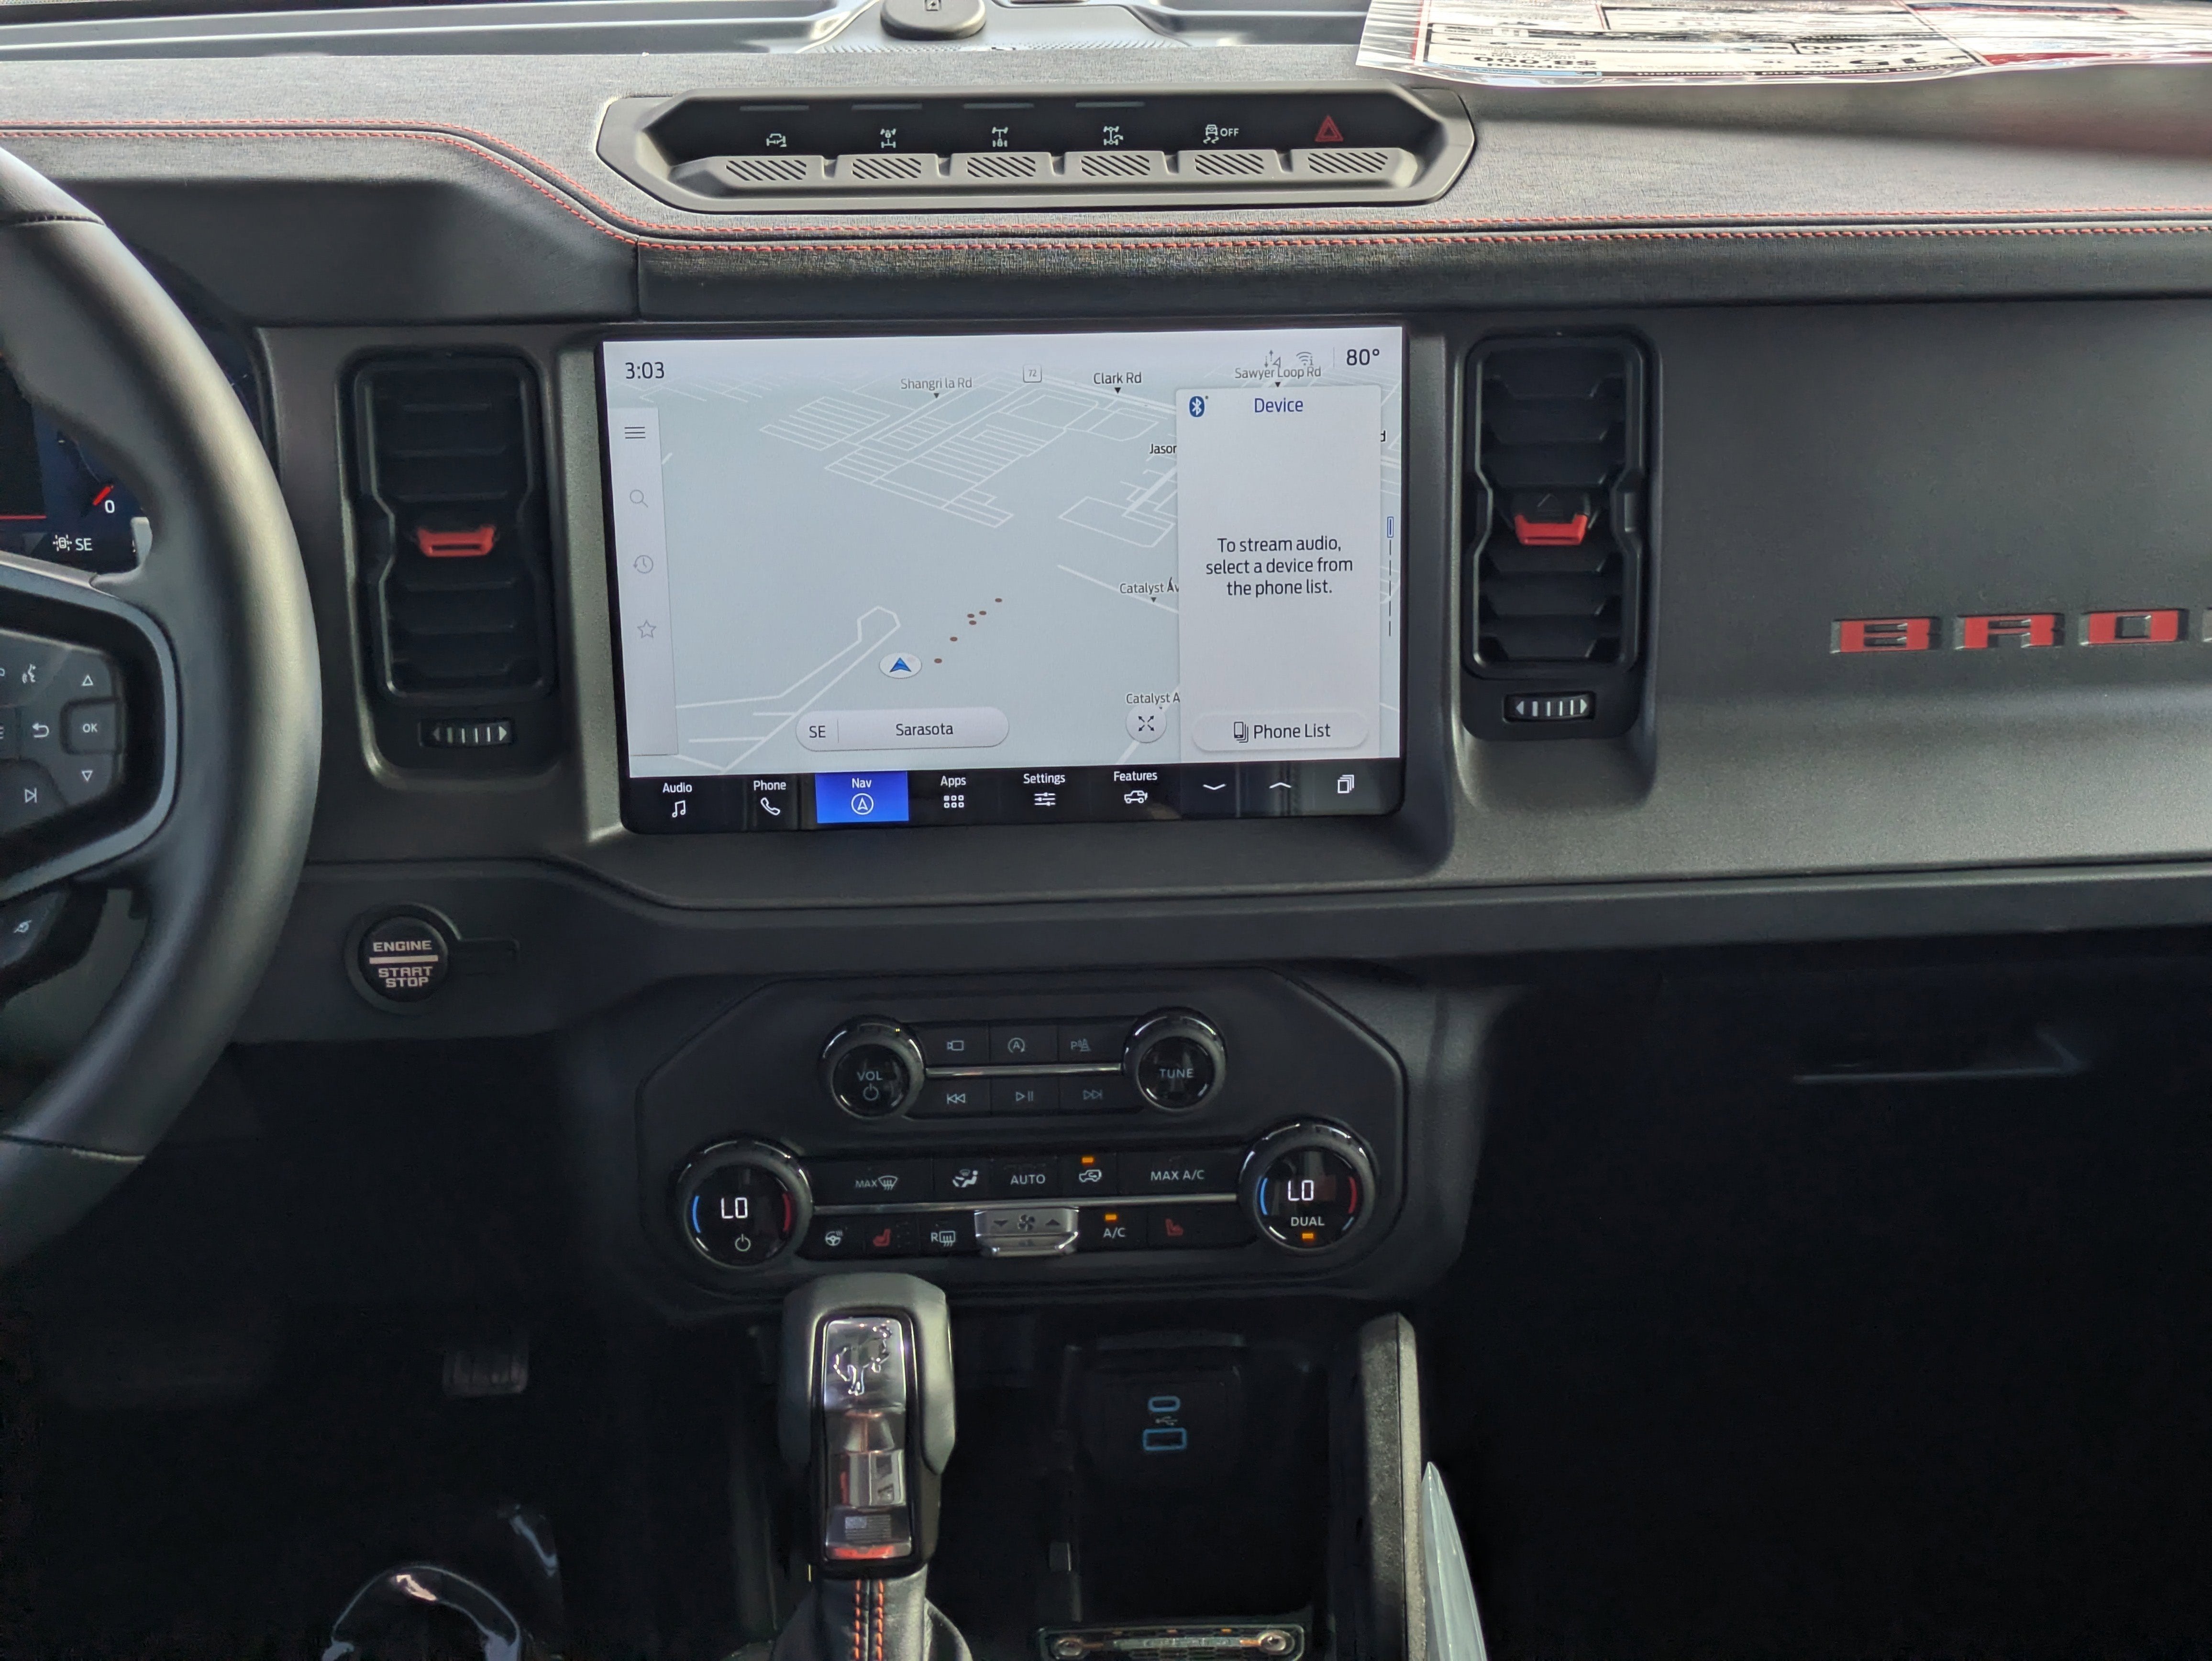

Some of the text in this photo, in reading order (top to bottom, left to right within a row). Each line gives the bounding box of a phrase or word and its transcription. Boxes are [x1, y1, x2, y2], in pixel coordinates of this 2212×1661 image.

[1220, 127, 1239, 137] OFF
[625, 362, 664, 379] 3:03
[1235, 368, 1275, 380] Sawyer
[1307, 366, 1321, 377] Rd
[901, 377, 972, 391] Shangri la Rd
[1094, 372, 1142, 384] Clark Rd
[1254, 397, 1304, 413] Device
[104, 499, 115, 513] 0
[75, 538, 93, 551] SE
[1217, 535, 1341, 553] To stream audio,
[1206, 557, 1353, 575] select a device from
[1120, 582, 1164, 595] Catalyst
[1227, 578, 1332, 598] the phone list.
[1830, 608, 2212, 654] BRO
[1126, 693, 1171, 705] Catalyst
[82, 723, 98, 733] OK
[809, 723, 953, 738] SE Sarasota
[1254, 723, 1331, 739] Phone List
[852, 777, 872, 788] Nav
[940, 775, 966, 788] Apps
[1023, 773, 1066, 785] Settings
[1114, 771, 1158, 782] Features
[663, 782, 693, 793] Audio
[753, 780, 786, 791] Phone
[373, 940, 432, 952] ENGINE
[378, 965, 433, 978] START
[385, 976, 429, 988] STOP
[857, 1071, 883, 1081] VOL
[1160, 1068, 1193, 1079] TUNE
[1010, 1174, 1046, 1185] AUTO
[1150, 1170, 1204, 1181] MAX A/C
[1288, 1180, 1314, 1201] LO
[720, 1197, 748, 1219] LO
[1291, 1216, 1325, 1227] DUAL
[1103, 1227, 1125, 1239] A/C
